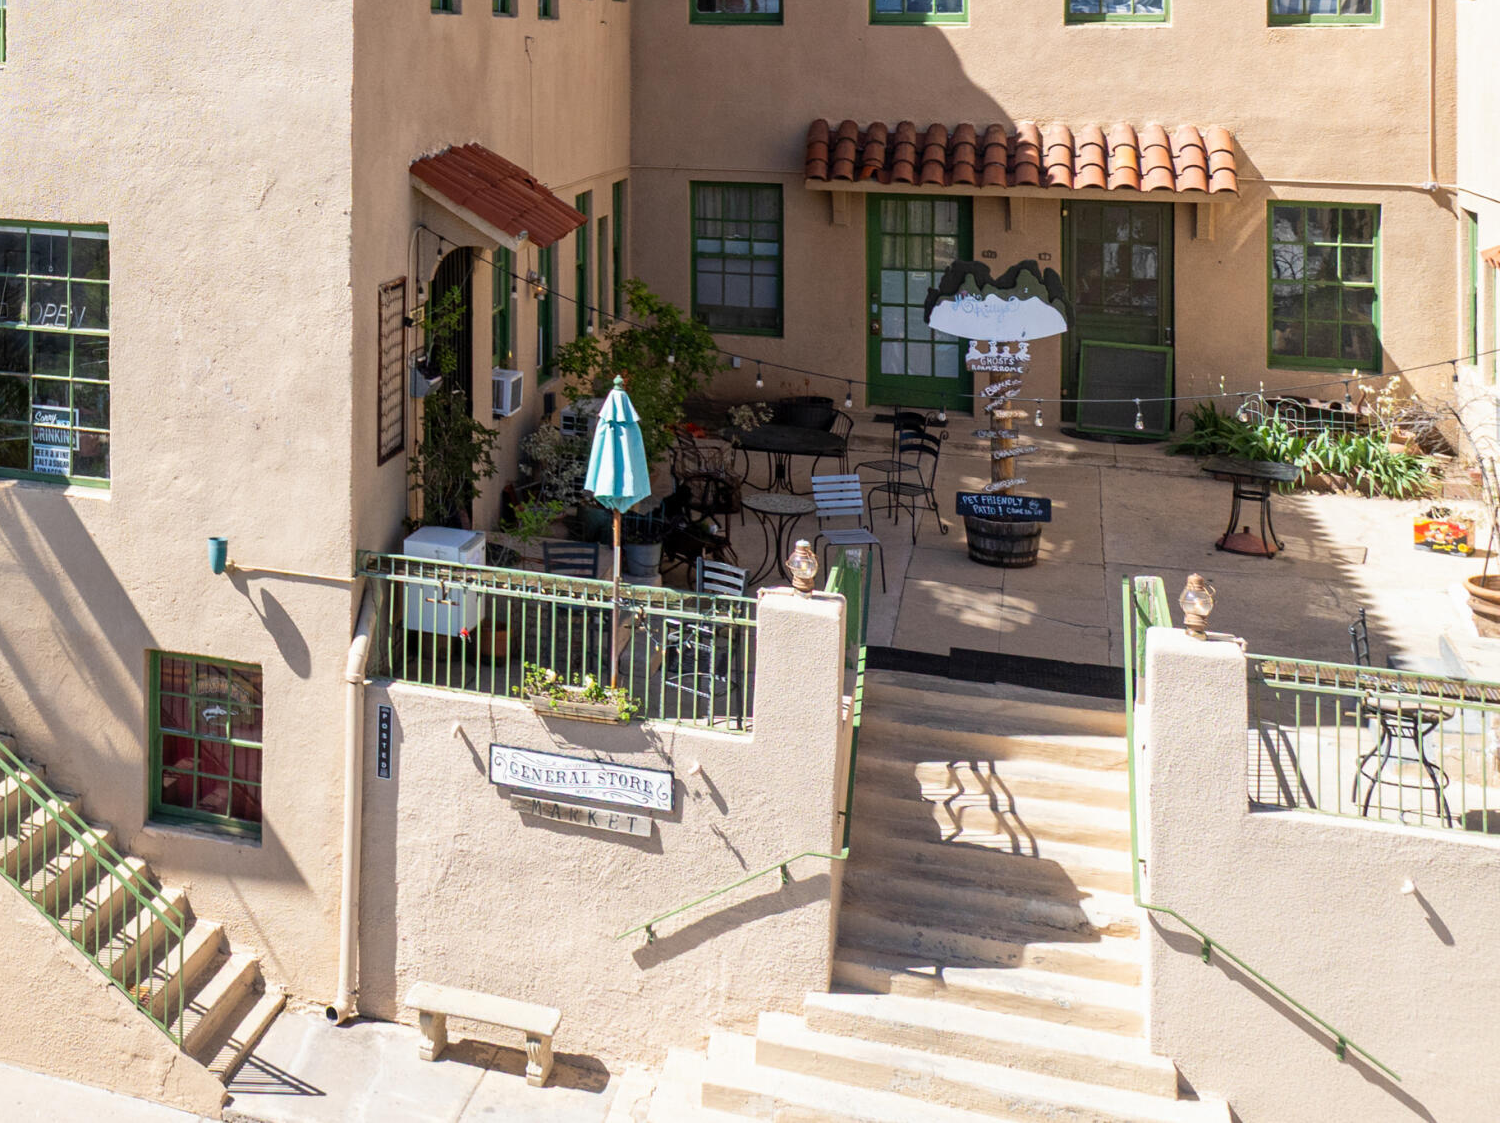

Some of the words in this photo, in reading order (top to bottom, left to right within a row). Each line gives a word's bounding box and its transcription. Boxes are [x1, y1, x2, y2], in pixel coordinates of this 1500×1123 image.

[980, 357, 1015, 366] GHOSTS
[962, 495, 979, 504] PET
[981, 496, 1023, 506] FRIENDLY
[509, 761, 591, 784] GENERAL
[597, 772, 653, 795] STORE
[531, 799, 638, 833] MARKET
